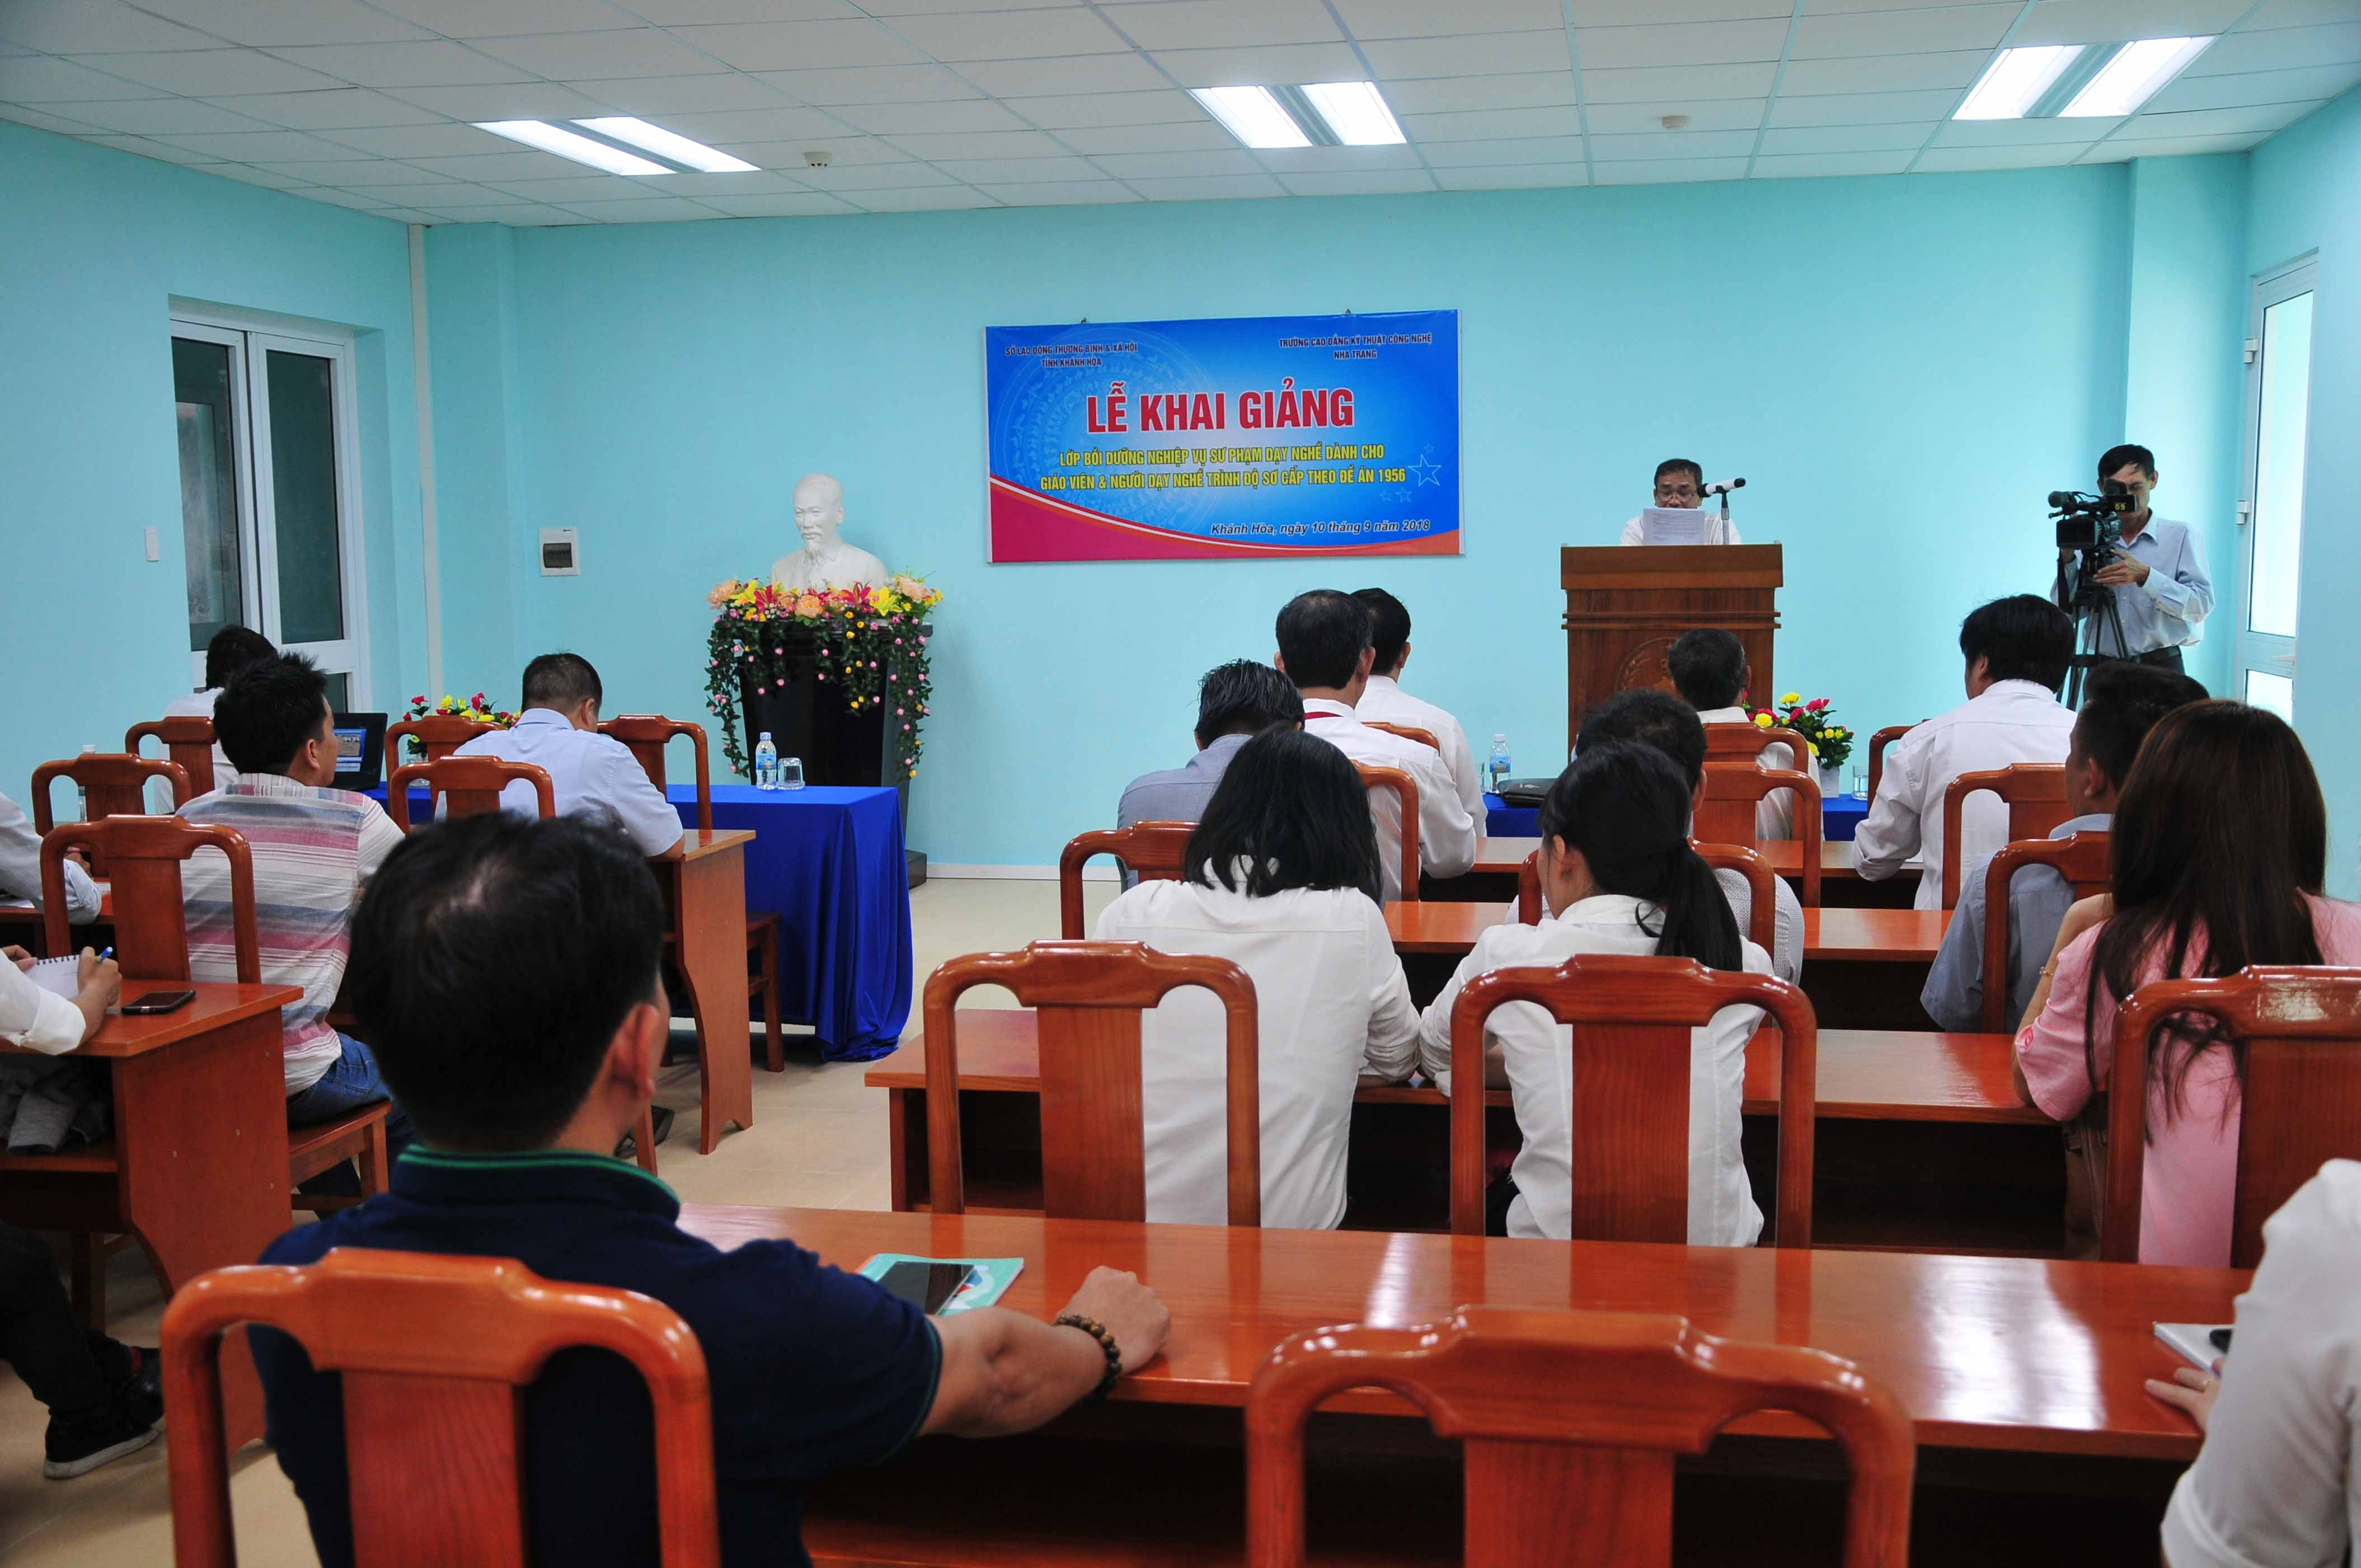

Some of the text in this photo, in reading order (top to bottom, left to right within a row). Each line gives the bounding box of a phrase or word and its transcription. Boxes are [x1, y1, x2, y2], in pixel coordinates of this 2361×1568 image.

[1279, 338, 1308, 348] TRƯỜNG
[1311, 339, 1326, 347] CAO
[1363, 334, 1386, 346] THUẬT
[1388, 334, 1409, 344] CÔNG
[1411, 332, 1431, 344] NGHỆ
[1017, 347, 1031, 355] LAO
[1055, 345, 1083, 354] THƯƠNG
[1085, 345, 1102, 353] BINH
[1125, 343, 1137, 354] HỘI
[1334, 350, 1377, 359] NHA TRANG
[1060, 356, 1085, 367] KHÁNH
[1087, 356, 1101, 367] HÒA
[1086, 375, 1355, 434] LỄ KHAI GIẢNG
[1059, 449, 1081, 466] LỚP
[1106, 448, 1144, 466] DƯỠNG
[1147, 447, 1189, 467] NGHIỆP
[1191, 449, 1207, 467] VỤ
[1209, 447, 1227, 463] SƯ
[1228, 447, 1262, 466] PHẠM
[1266, 447, 1289, 464] DẠY
[1326, 442, 1357, 461] DÀNH
[1361, 444, 1384, 459] CHO
[1041, 473, 1066, 490] GIÁO
[1069, 472, 1095, 490] VIÊN
[1099, 476, 1106, 489] &
[1110, 471, 1145, 489] NGƯỜI
[1148, 473, 1170, 491] DẠY
[1207, 469, 1241, 487] TRÌNH
[1243, 468, 1259, 489] ĐỘ
[1262, 470, 1279, 486] SƠ
[1281, 466, 1304, 485] CẤP
[1308, 469, 1336, 485] THEO
[1358, 466, 1374, 483] ÁN
[1377, 467, 1406, 483] 1956
[1210, 519, 1431, 536] Khánh Hòa, ngày 10 tháng 9 năm 2018
